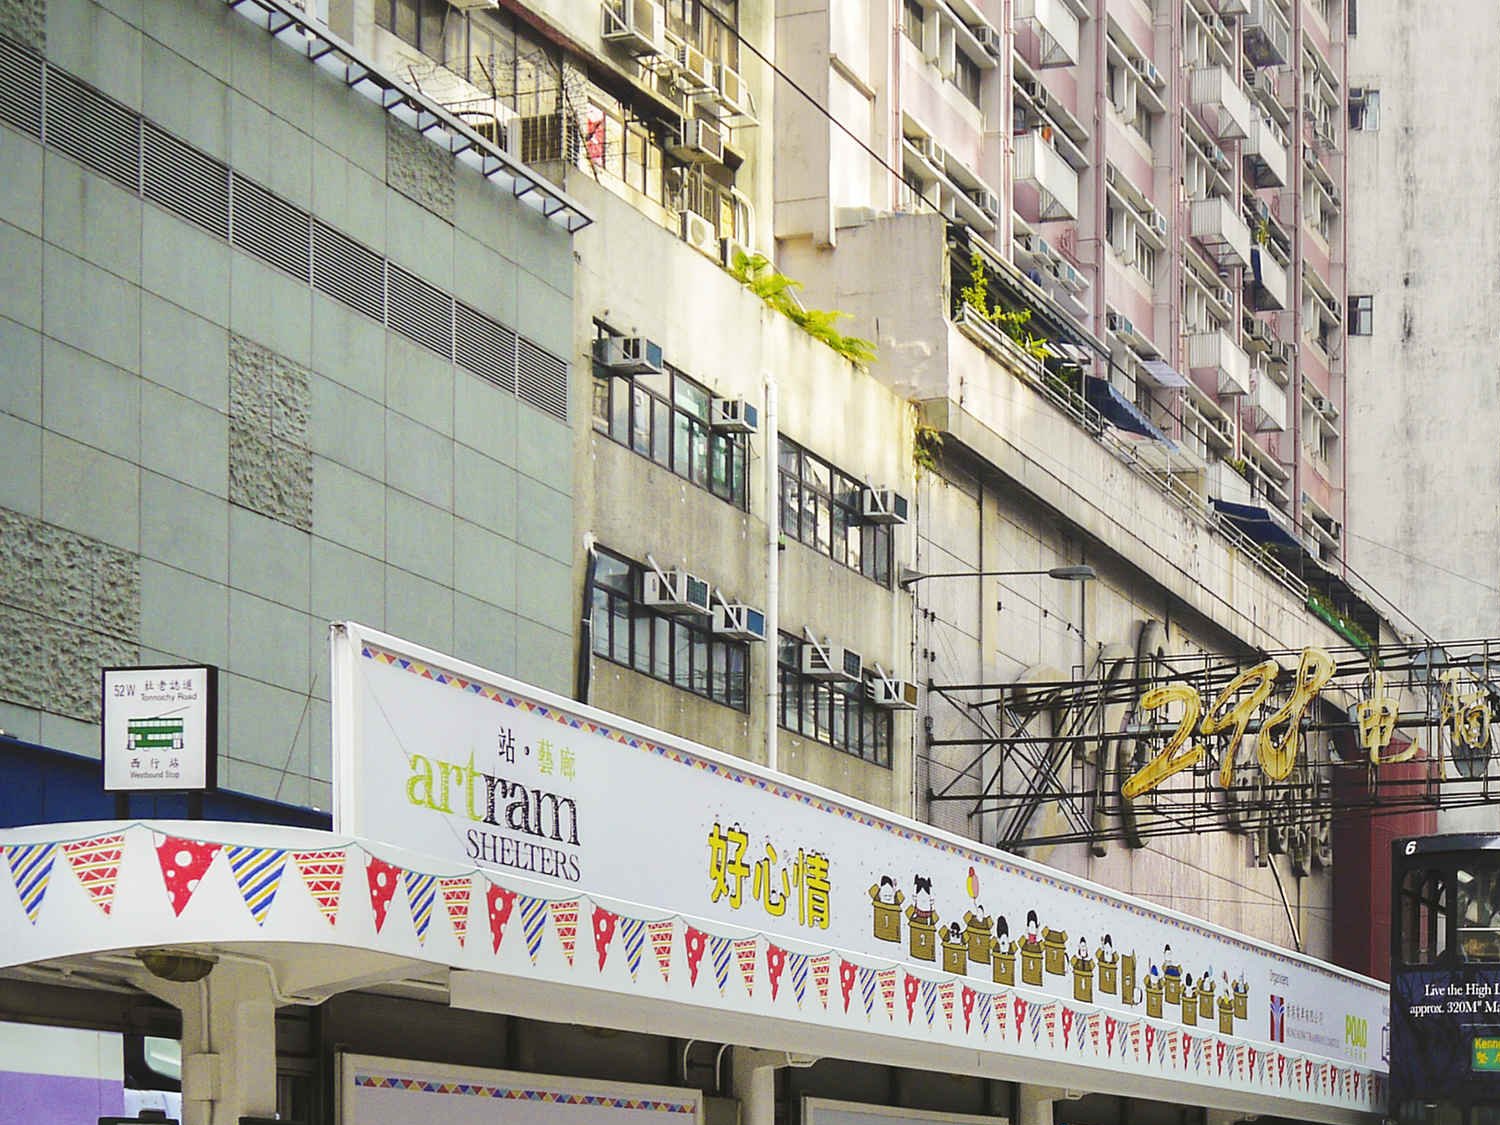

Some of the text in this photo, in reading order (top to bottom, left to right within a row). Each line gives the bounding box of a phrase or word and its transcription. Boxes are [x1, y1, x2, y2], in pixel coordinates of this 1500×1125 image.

[1120, 645, 1338, 800] 298
[405, 745, 582, 847] artram
[465, 828, 582, 883] SHELTERS
[1404, 840, 1417, 855] 6
[707, 821, 832, 930] 好心情
[1409, 1004, 1445, 1018] approx.
[1424, 983, 1446, 996] Live
[1447, 983, 1464, 996] the
[1465, 982, 1492, 999] High
